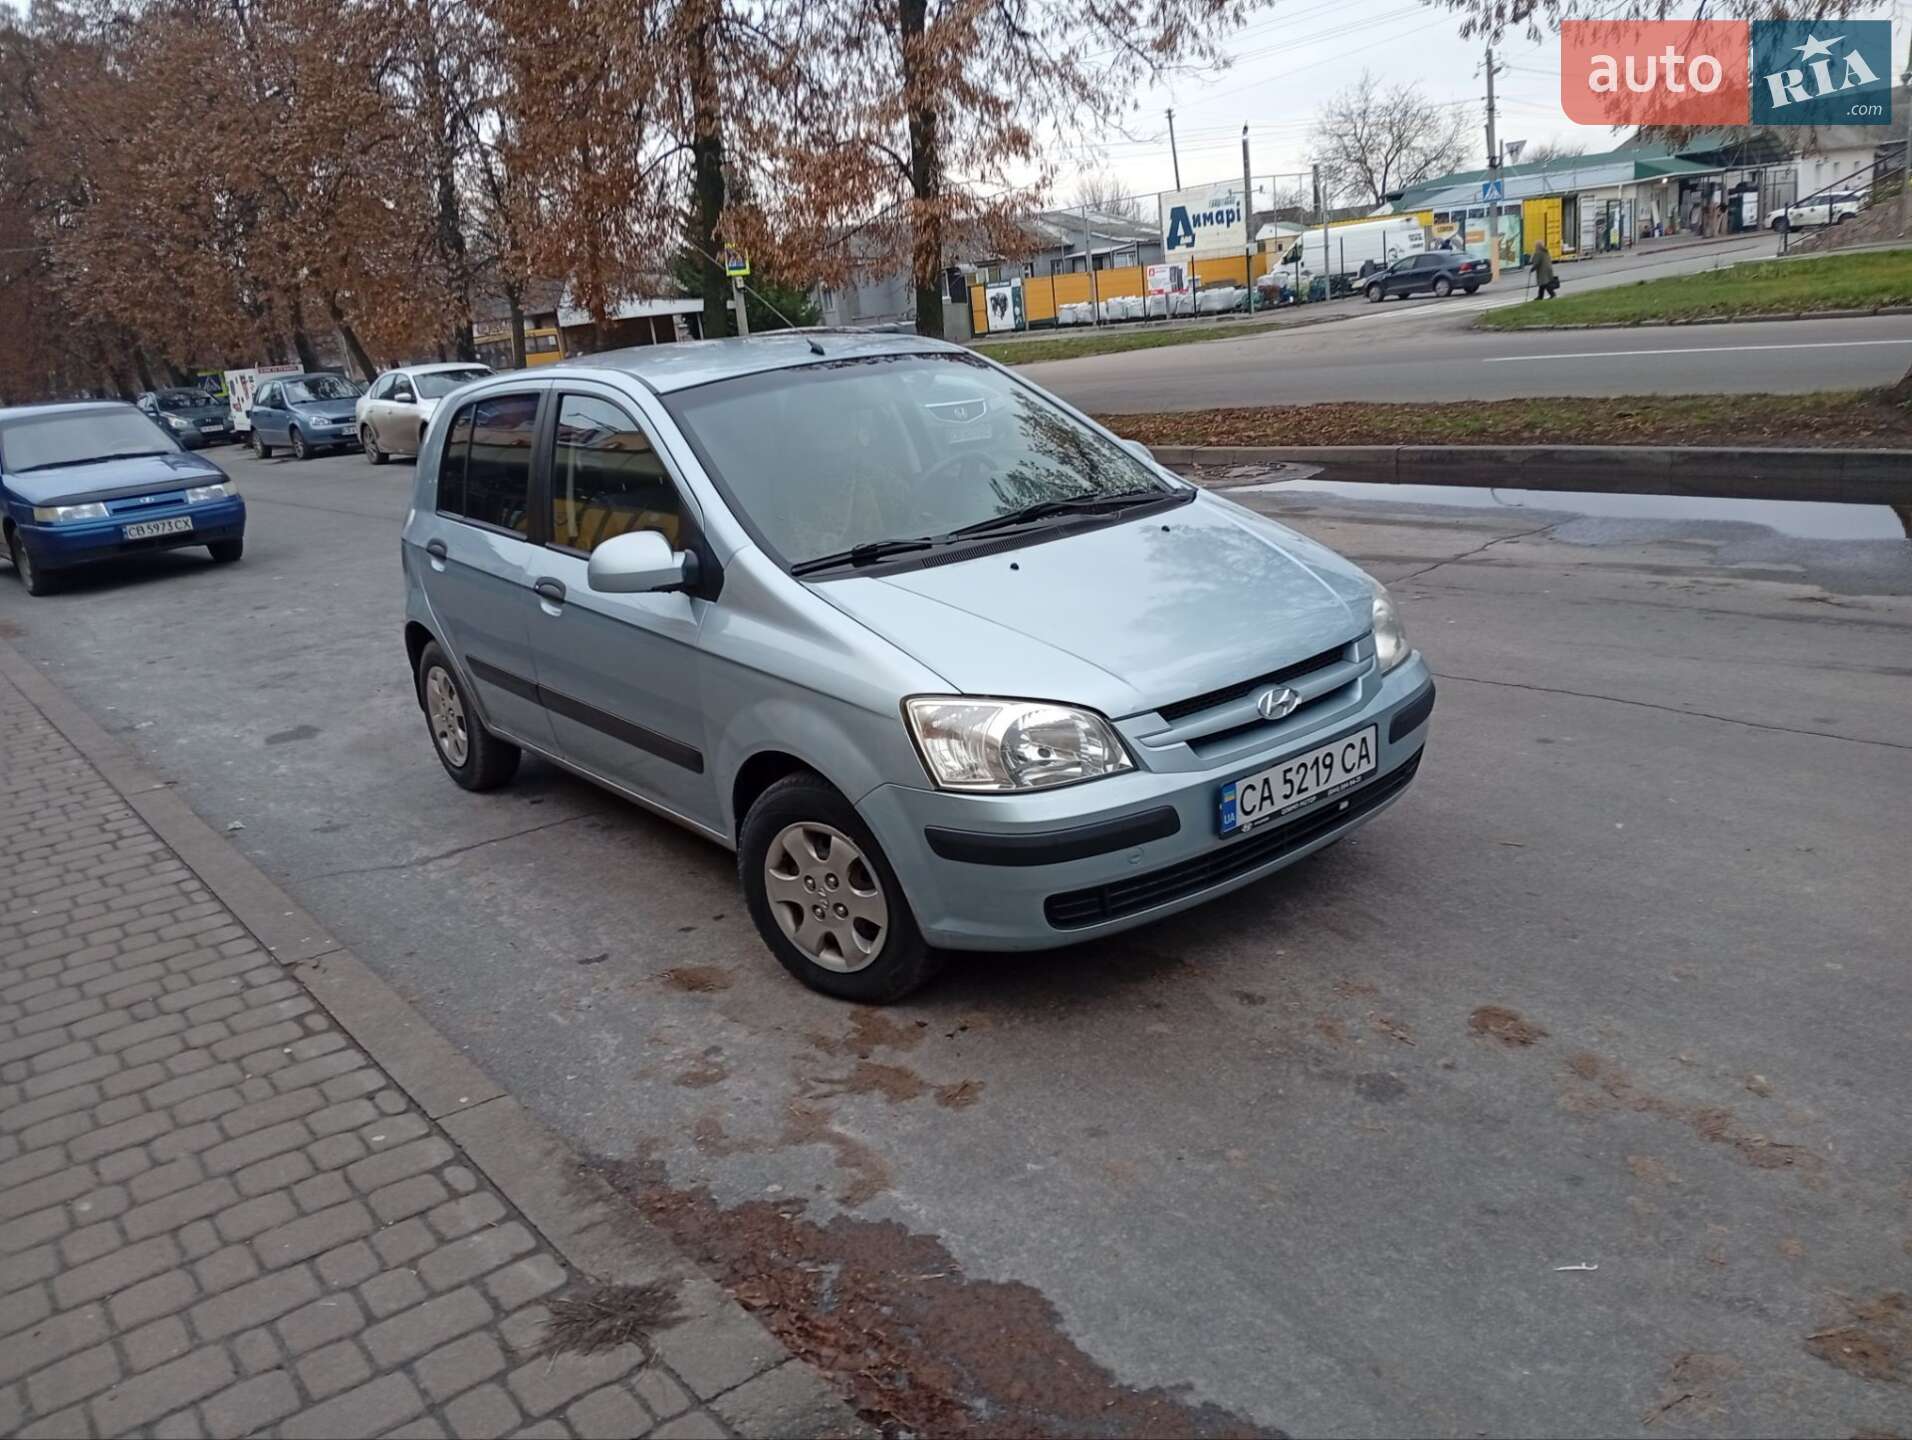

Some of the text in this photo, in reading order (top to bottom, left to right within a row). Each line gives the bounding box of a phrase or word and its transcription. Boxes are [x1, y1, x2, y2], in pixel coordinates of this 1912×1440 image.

[1167, 201, 1241, 250] Димарі
[146, 520, 174, 535] 5973
[175, 518, 191, 530] CX
[1239, 777, 1275, 816] CA
[1282, 751, 1334, 800] 5219
[1341, 736, 1371, 774] CA
